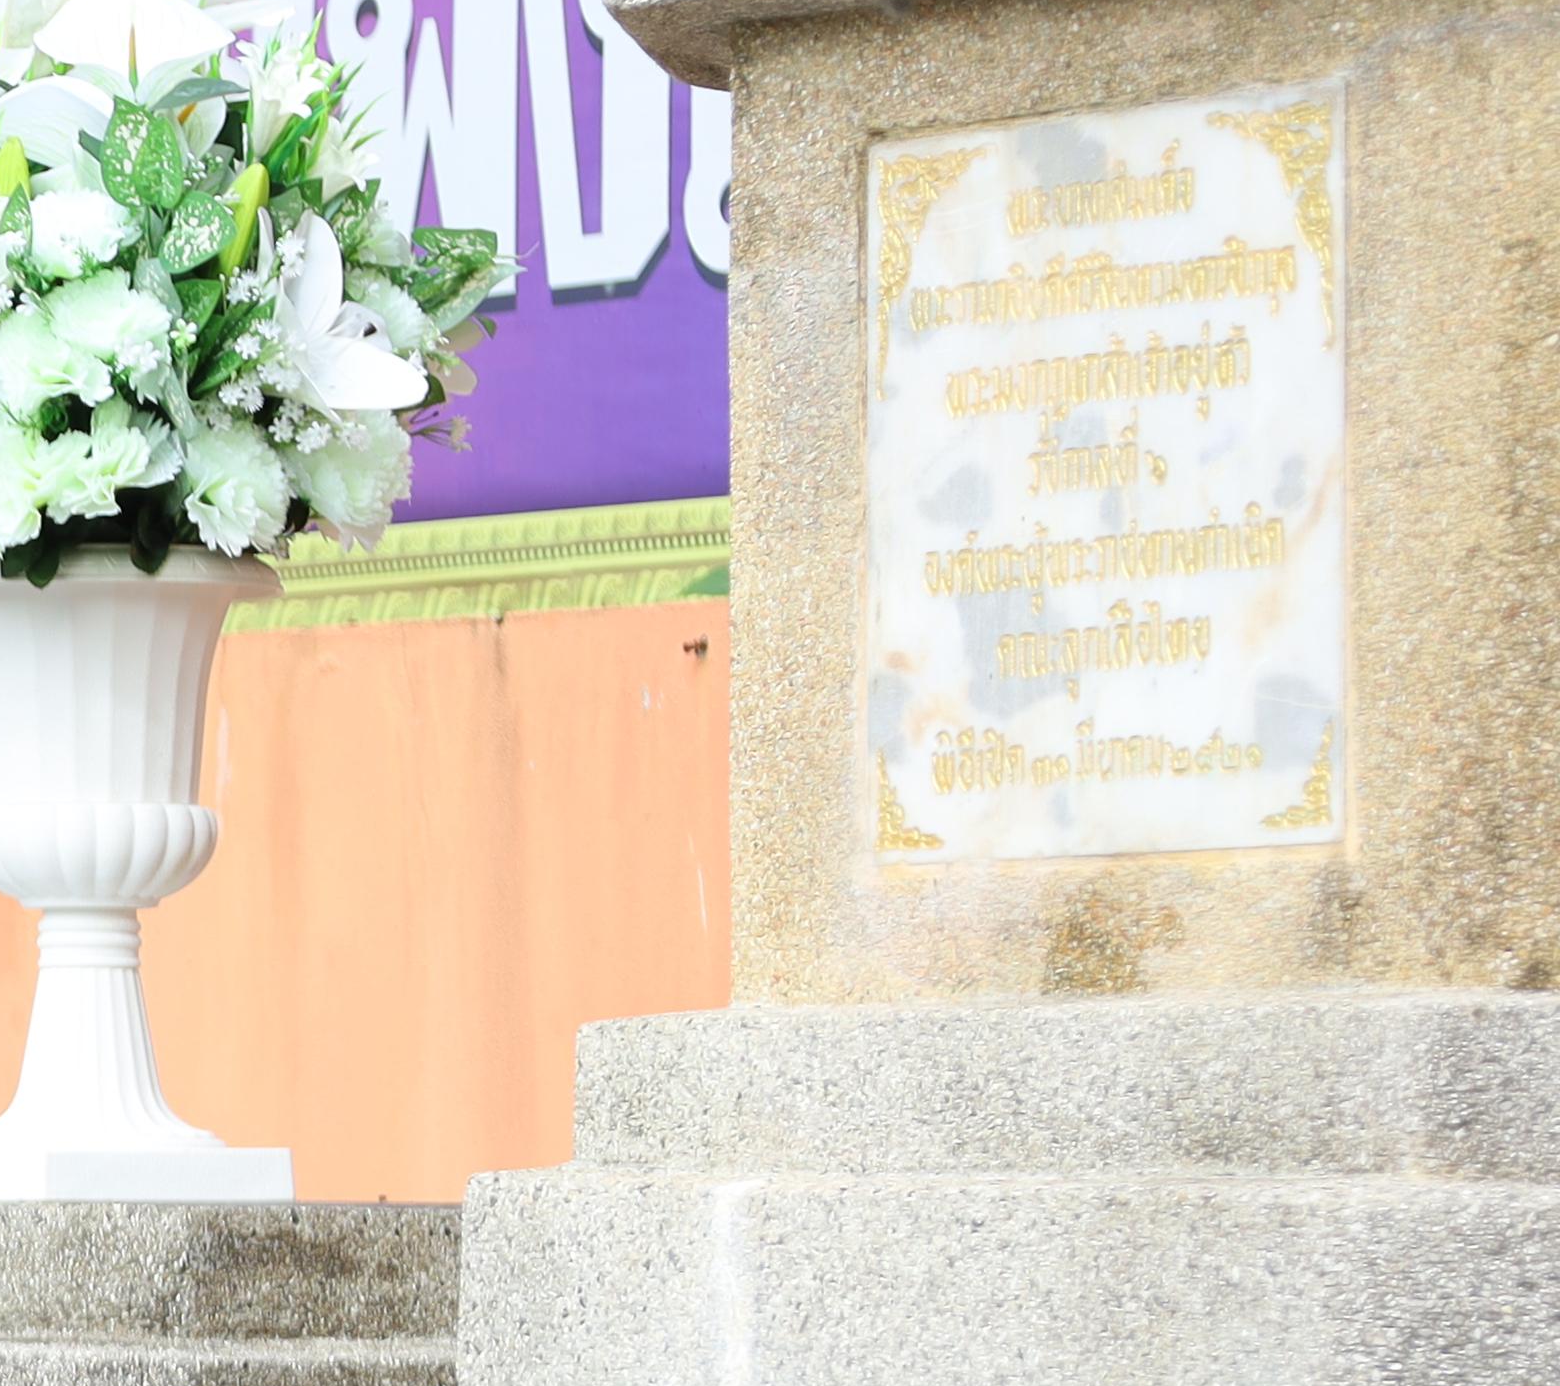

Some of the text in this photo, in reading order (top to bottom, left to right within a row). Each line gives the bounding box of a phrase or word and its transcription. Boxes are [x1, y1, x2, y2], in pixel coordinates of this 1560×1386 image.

[997, 598, 1212, 703] คณะลูกเสือไทย
